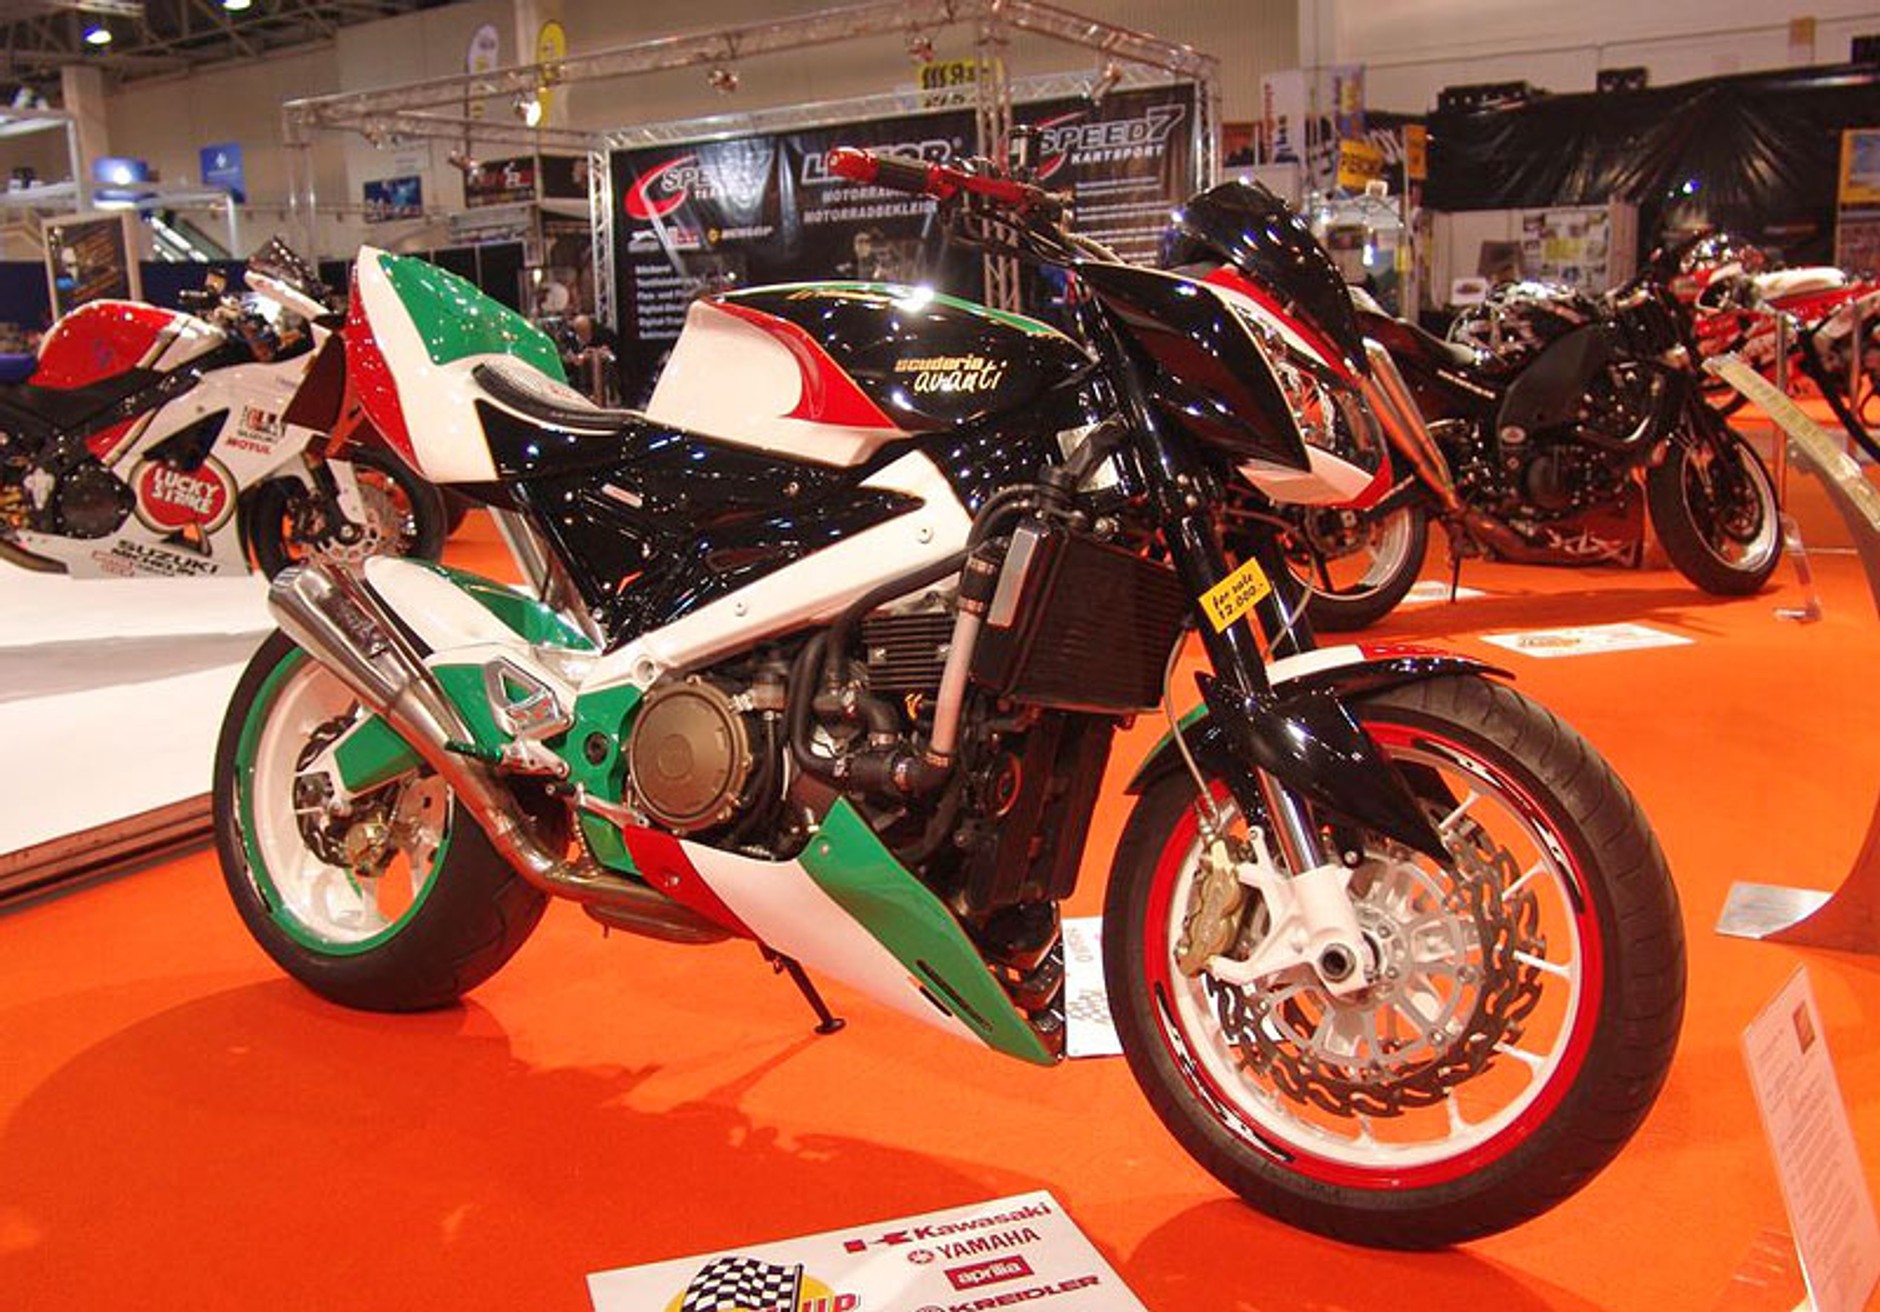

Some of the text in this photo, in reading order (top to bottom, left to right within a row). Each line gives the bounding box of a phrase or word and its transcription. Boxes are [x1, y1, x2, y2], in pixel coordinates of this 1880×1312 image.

[1071, 145, 1164, 164] KARTSPORT
[895, 353, 984, 373] scuderia
[913, 360, 1008, 393] avanti
[226, 436, 272, 456] MOTUL
[151, 481, 213, 515] STRIKE
[153, 466, 220, 505] LUCKY
[119, 540, 218, 575] SUZUKI
[914, 1202, 1051, 1240] Kawasaki
[936, 1226, 1041, 1260] YAMAHA
[957, 1261, 1021, 1286] aprilia
[948, 1274, 1100, 1312] KREIDLER
